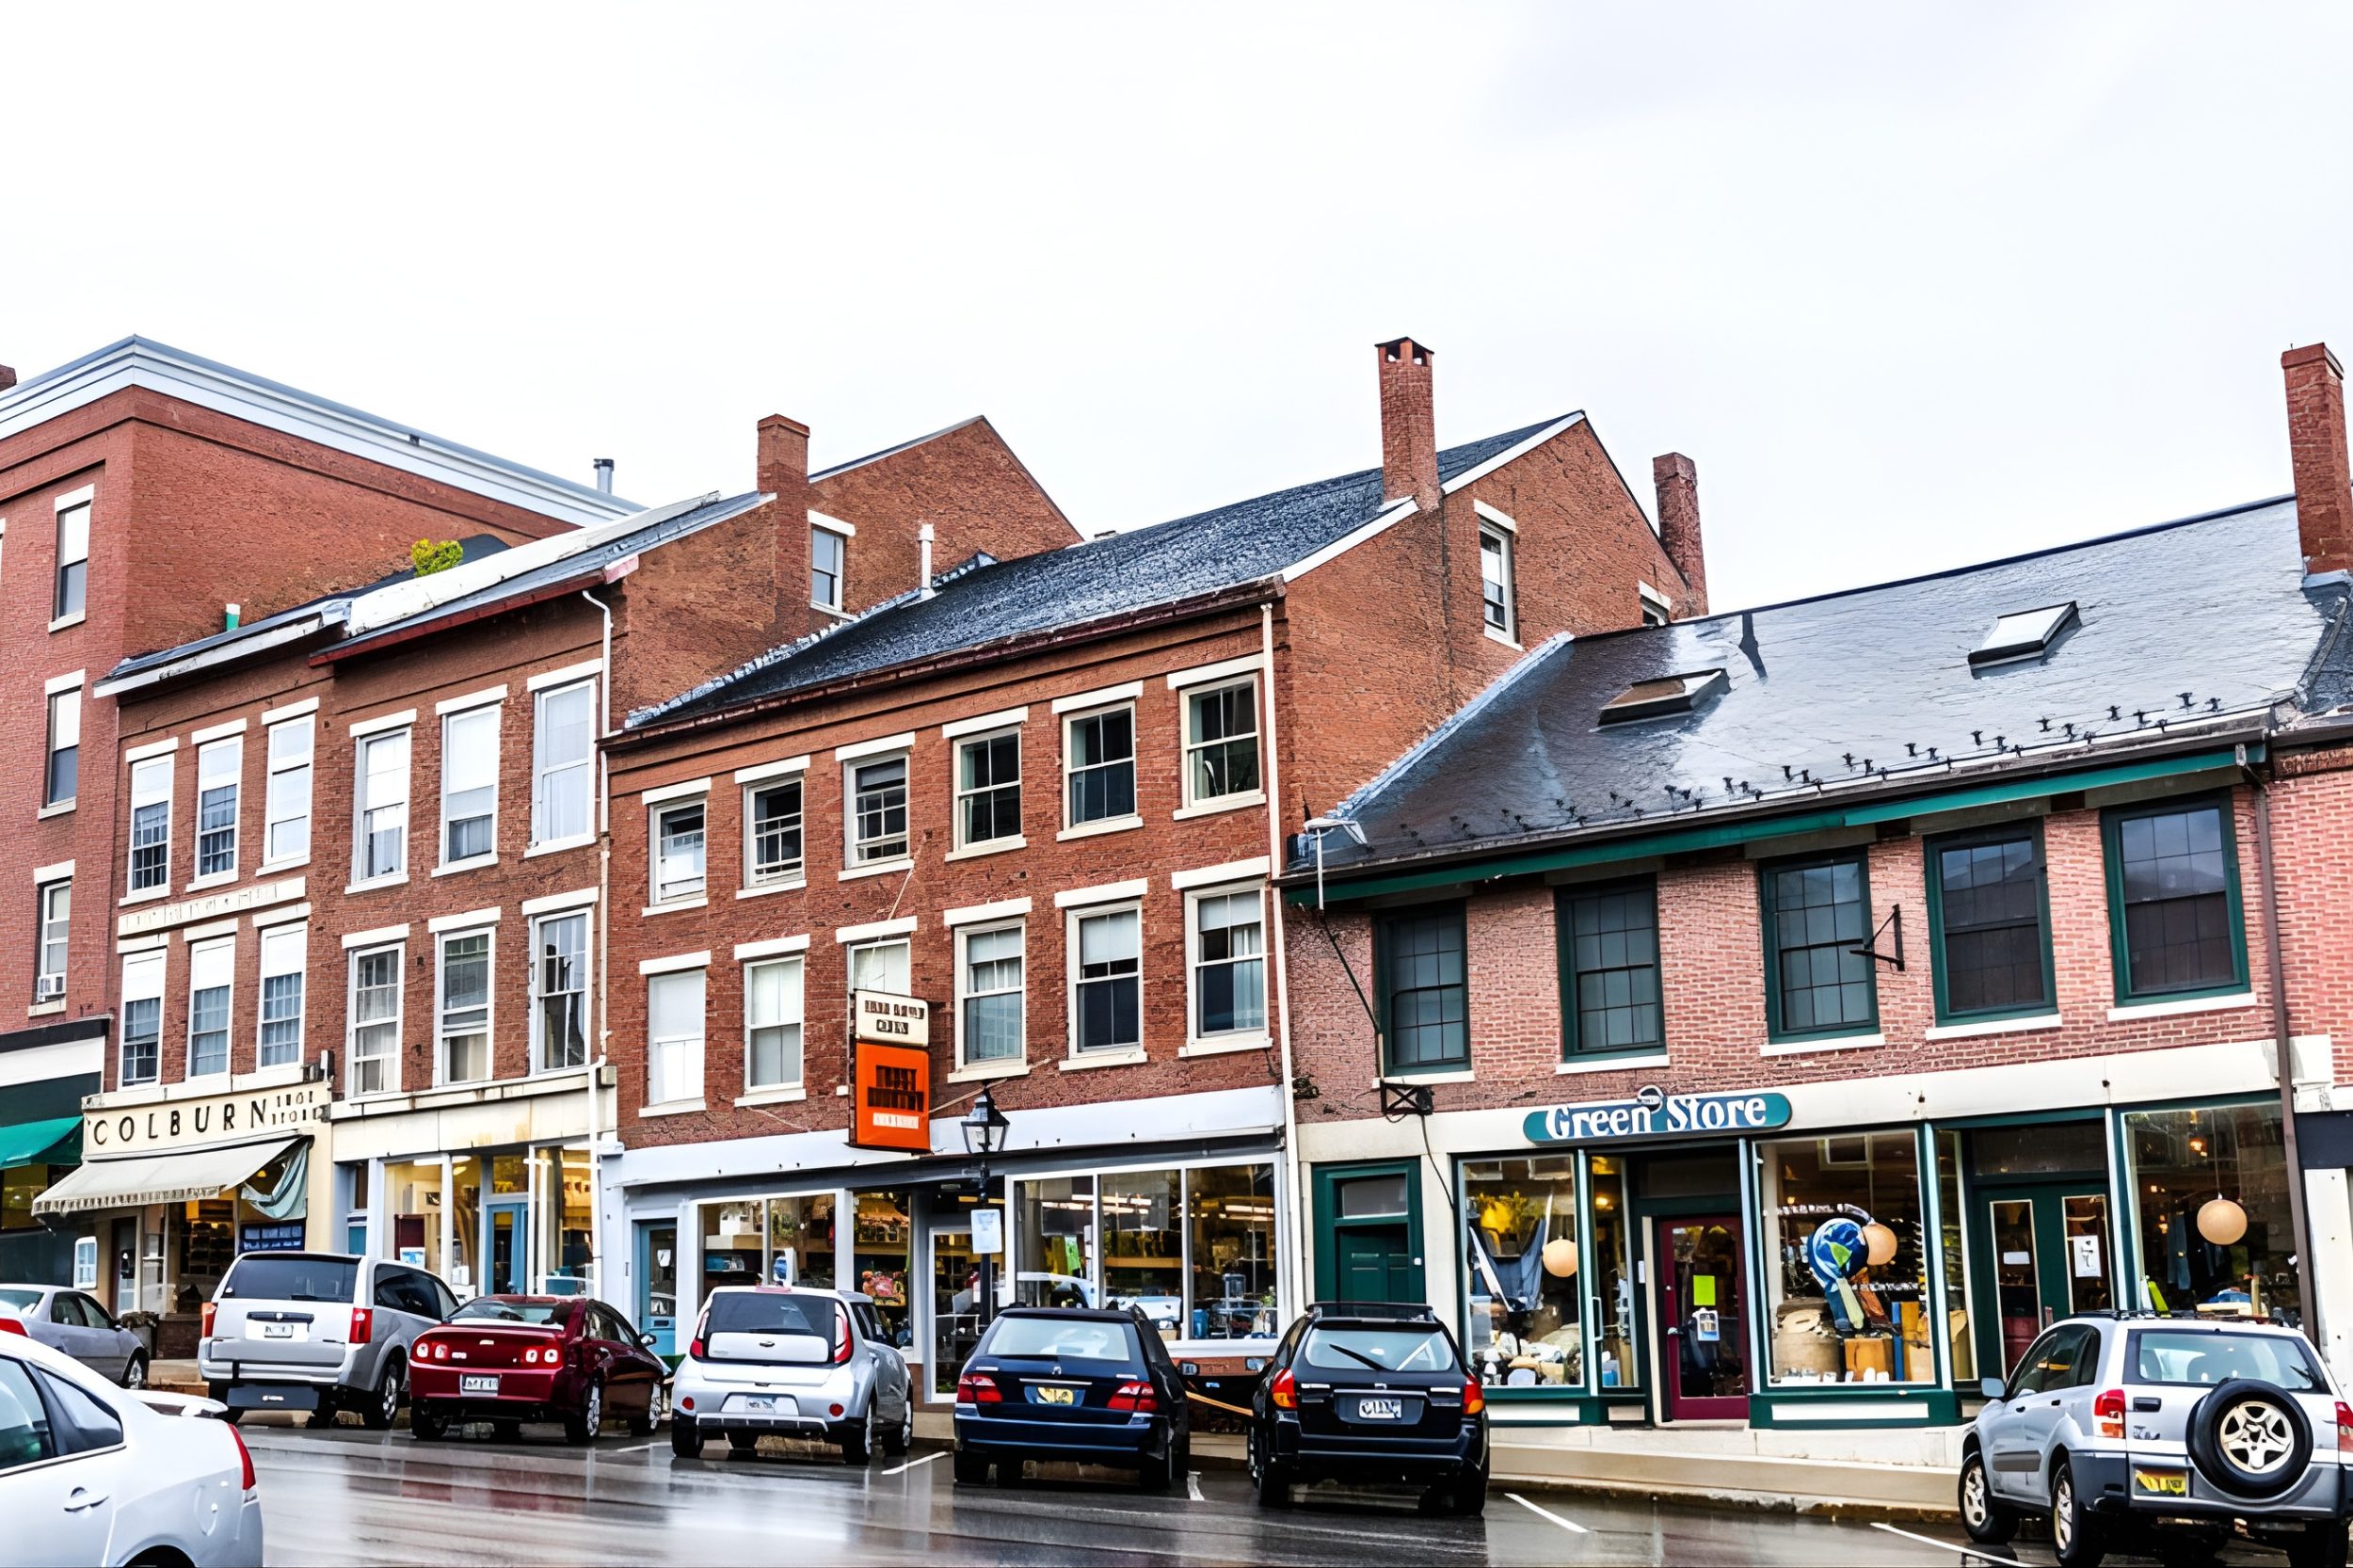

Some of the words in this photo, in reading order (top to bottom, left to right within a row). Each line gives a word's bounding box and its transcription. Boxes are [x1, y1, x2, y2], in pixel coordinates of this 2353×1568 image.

[93, 1098, 266, 1145] COLBURN
[1545, 1105, 1651, 1140] Green
[1666, 1096, 1767, 1131] Store
